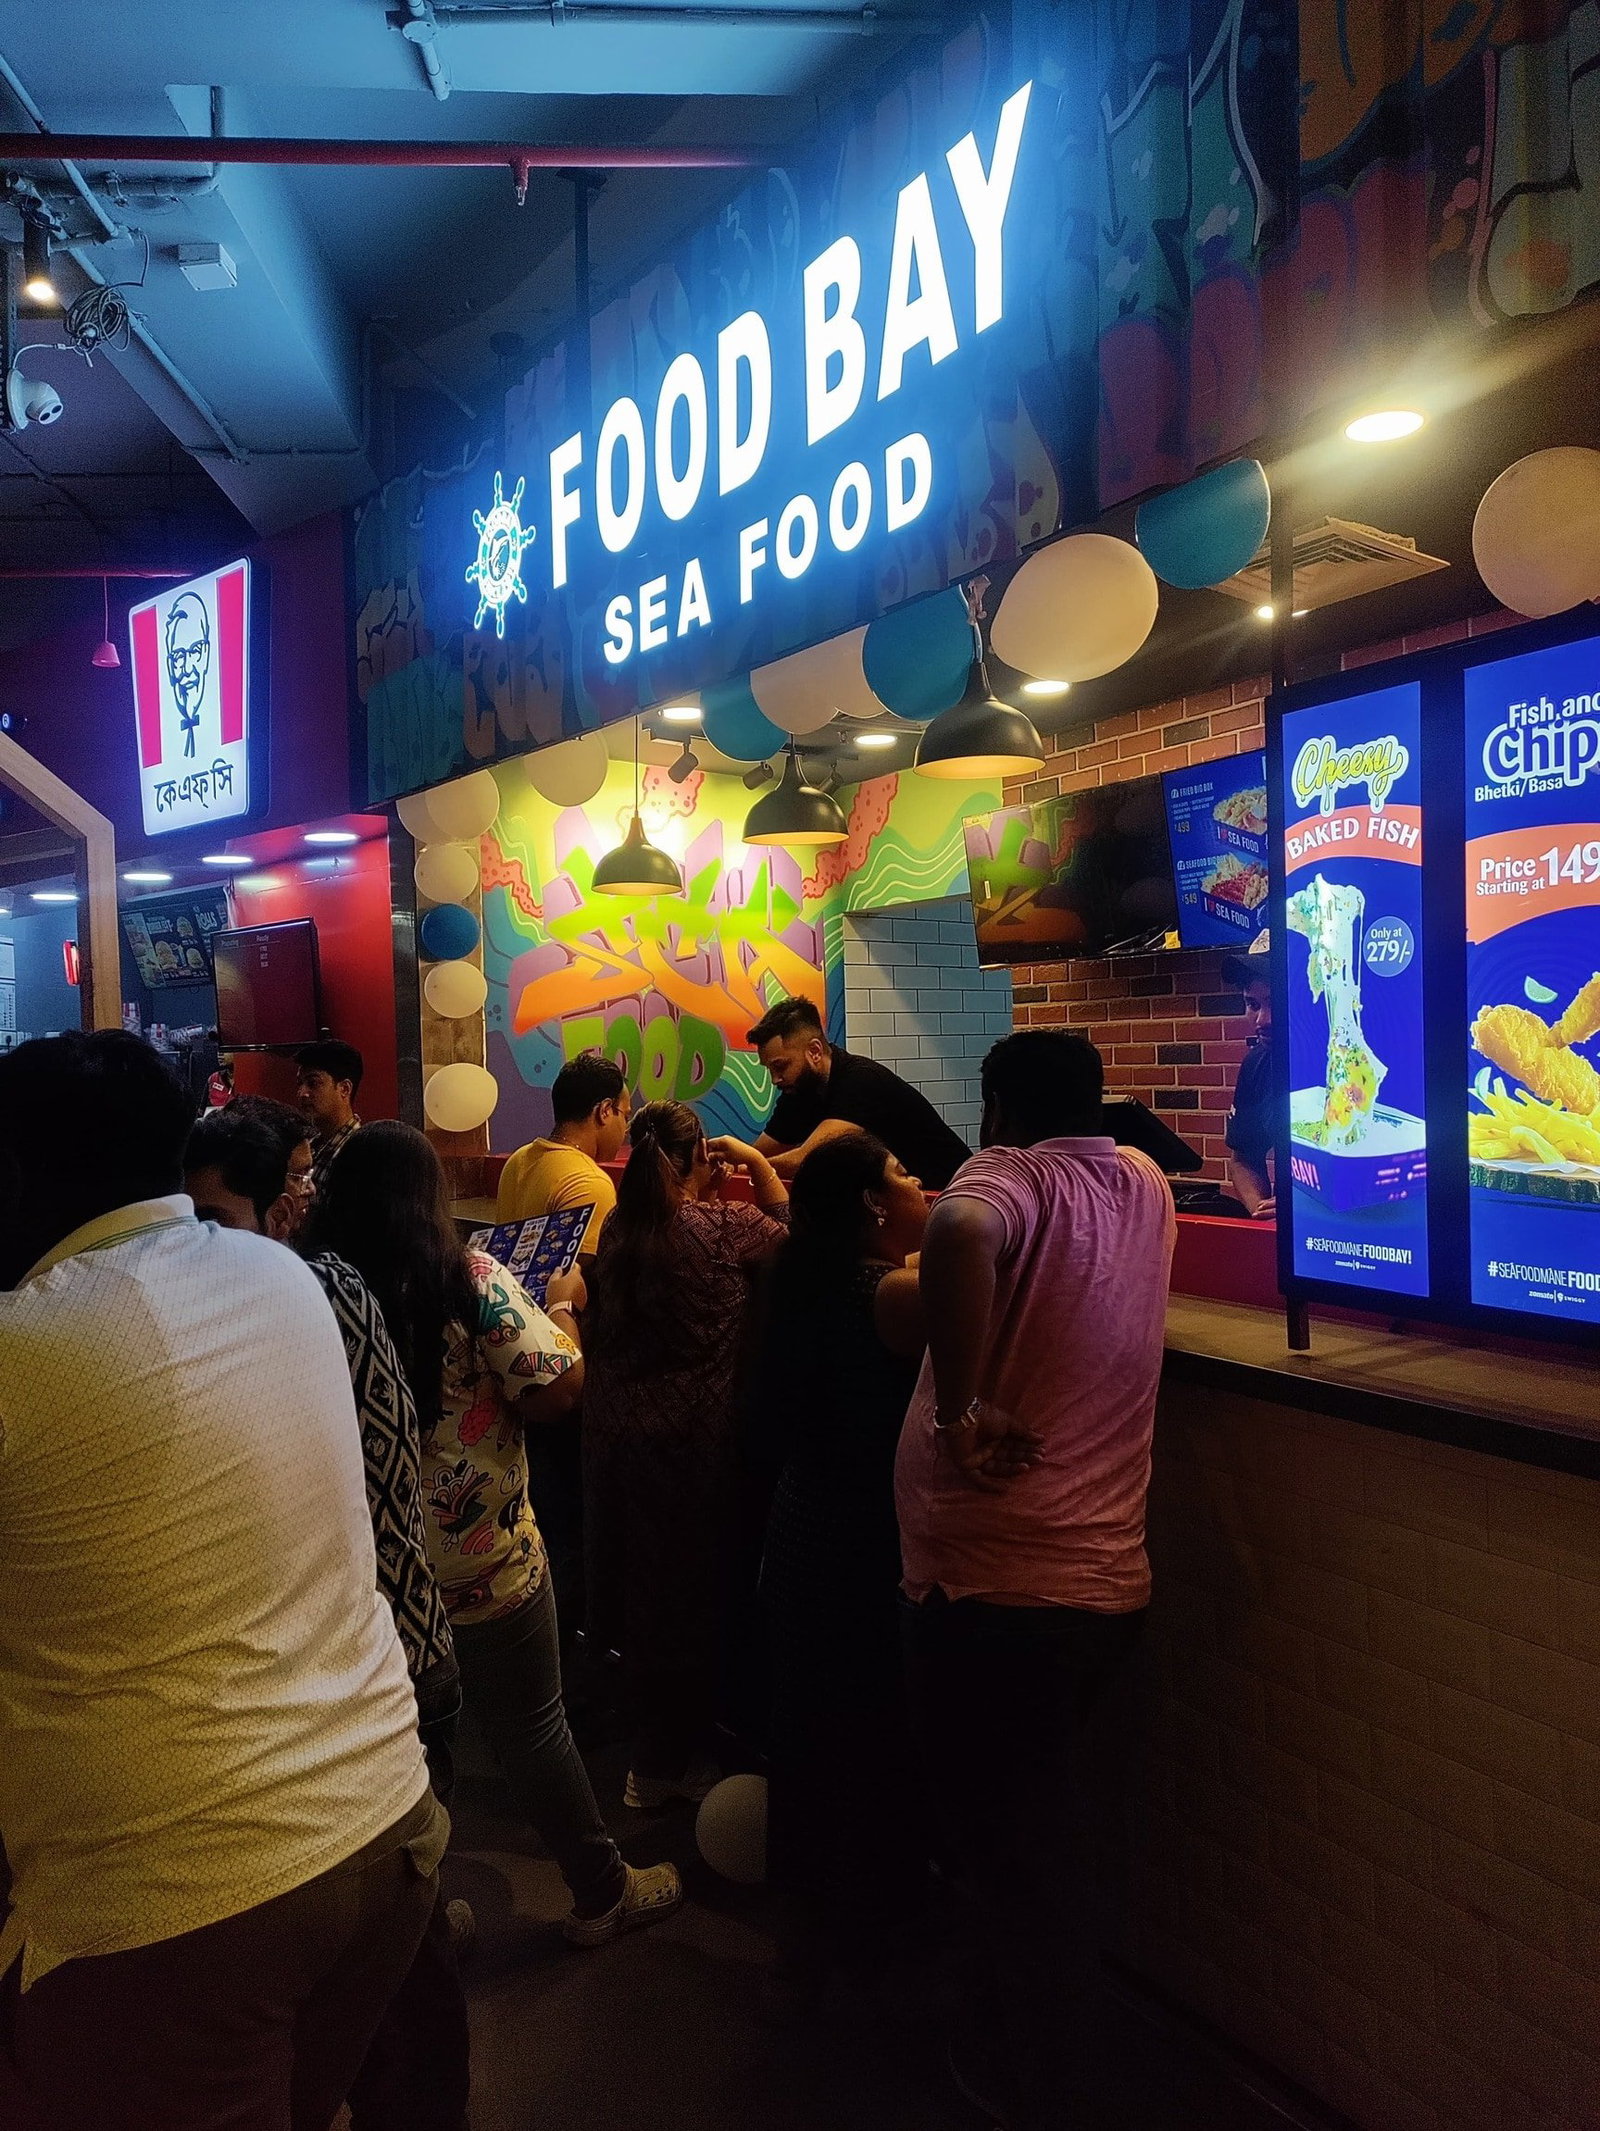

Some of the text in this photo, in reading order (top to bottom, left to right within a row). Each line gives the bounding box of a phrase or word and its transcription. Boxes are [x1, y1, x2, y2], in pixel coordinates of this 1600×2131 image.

[549, 79, 1033, 589] FOOD BAY
[603, 432, 934, 665] SEA FOOD
[1509, 697, 1554, 728] Fish
[1293, 736, 1409, 808] Cheesy
[1228, 831, 1241, 846] SEA
[1242, 837, 1259, 853] FOOD
[1287, 816, 1419, 859] BAKED FISH
[1481, 857, 1536, 882] Price
[1476, 876, 1545, 895] Starting at
[1216, 903, 1230, 920] SEA
[1231, 910, 1250, 928] FOOD
[1371, 927, 1402, 941] Only at
[1366, 941, 1411, 963] 279/-
[561, 1207, 591, 1269] FOOD
[1363, 1244, 1412, 1265] FOODBAY!
[1529, 1290, 1554, 1300] zomato
